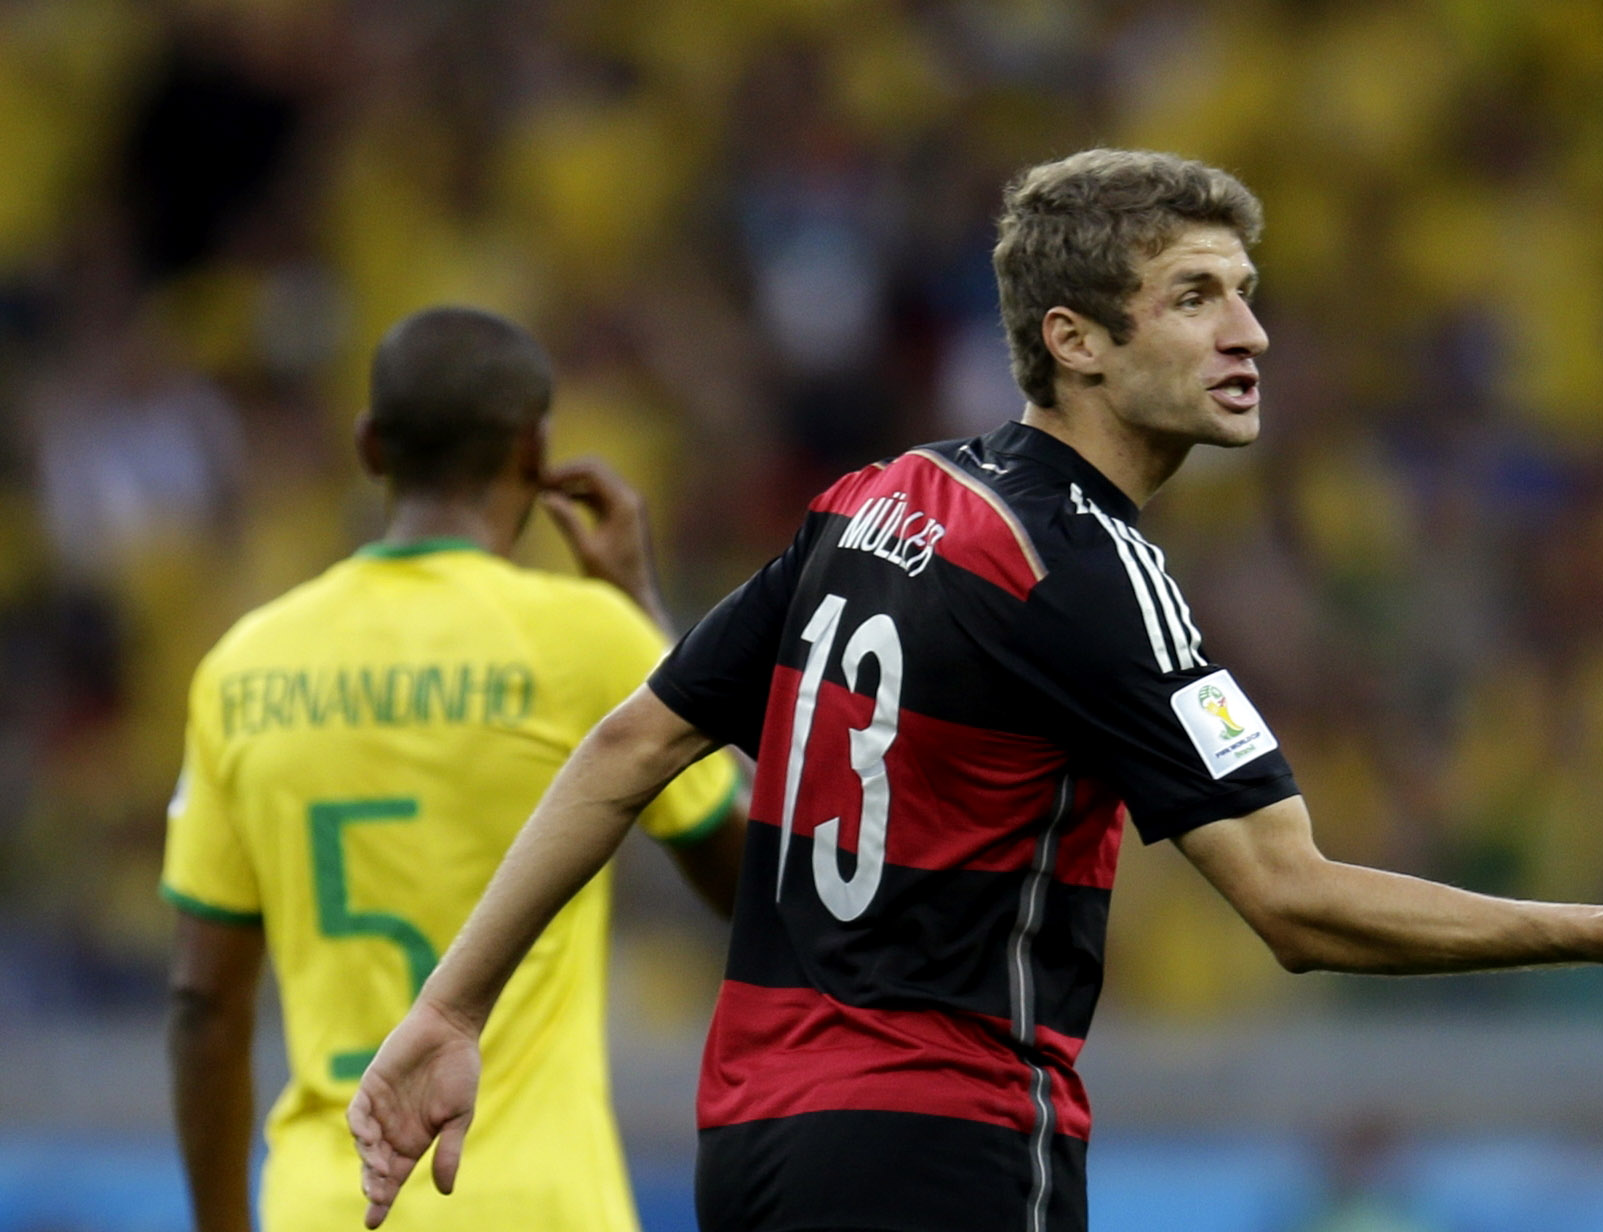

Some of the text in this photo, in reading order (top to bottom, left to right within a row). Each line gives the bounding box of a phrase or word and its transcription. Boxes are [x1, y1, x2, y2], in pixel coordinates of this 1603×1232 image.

[217, 662, 538, 739] FERNANDINHO
[777, 593, 903, 922] 13
[308, 797, 441, 1081] 5
